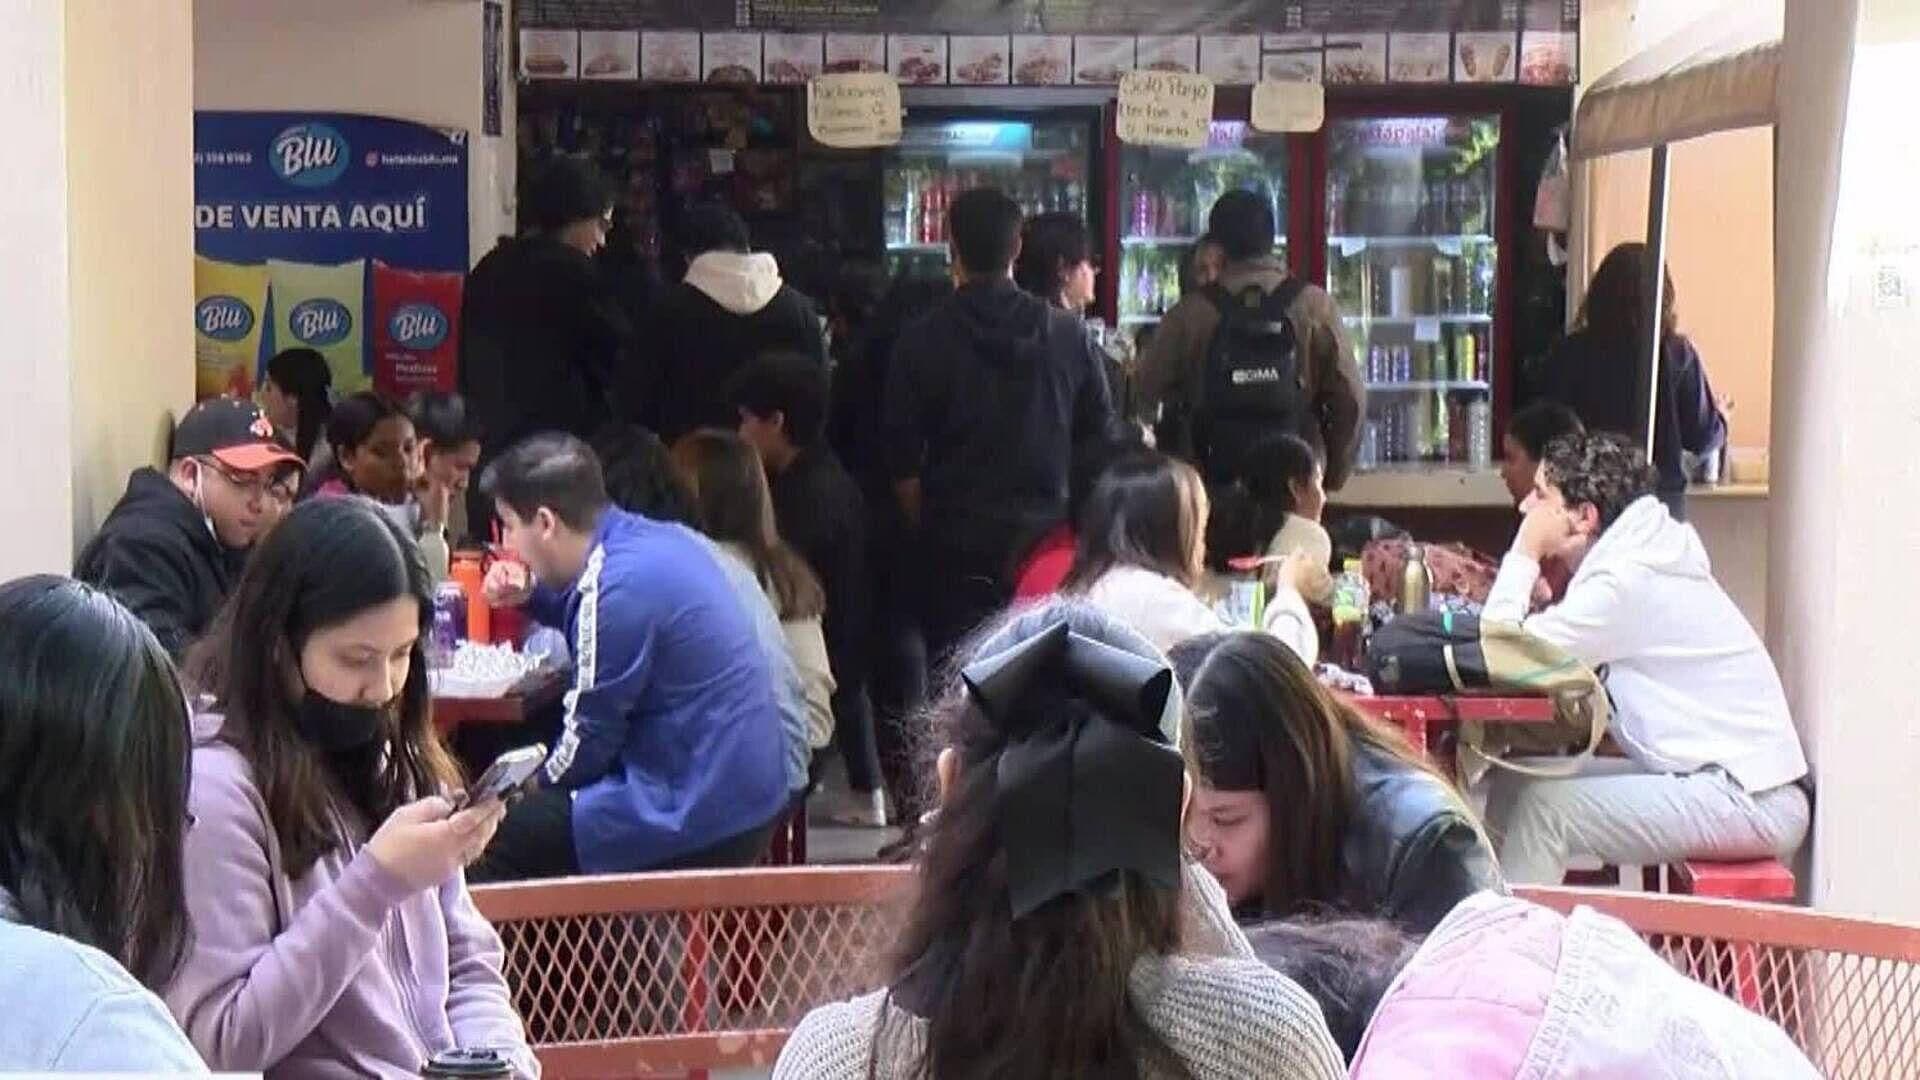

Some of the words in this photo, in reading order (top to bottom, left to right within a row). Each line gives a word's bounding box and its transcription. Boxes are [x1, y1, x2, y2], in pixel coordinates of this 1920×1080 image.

[276, 130, 337, 176] Blu
[195, 205, 234, 229] DE
[240, 204, 342, 229] VENTA
[349, 196, 427, 233] AQUÍ
[201, 304, 242, 331] Blu
[299, 306, 340, 338] Blu
[397, 309, 438, 341] Blu
